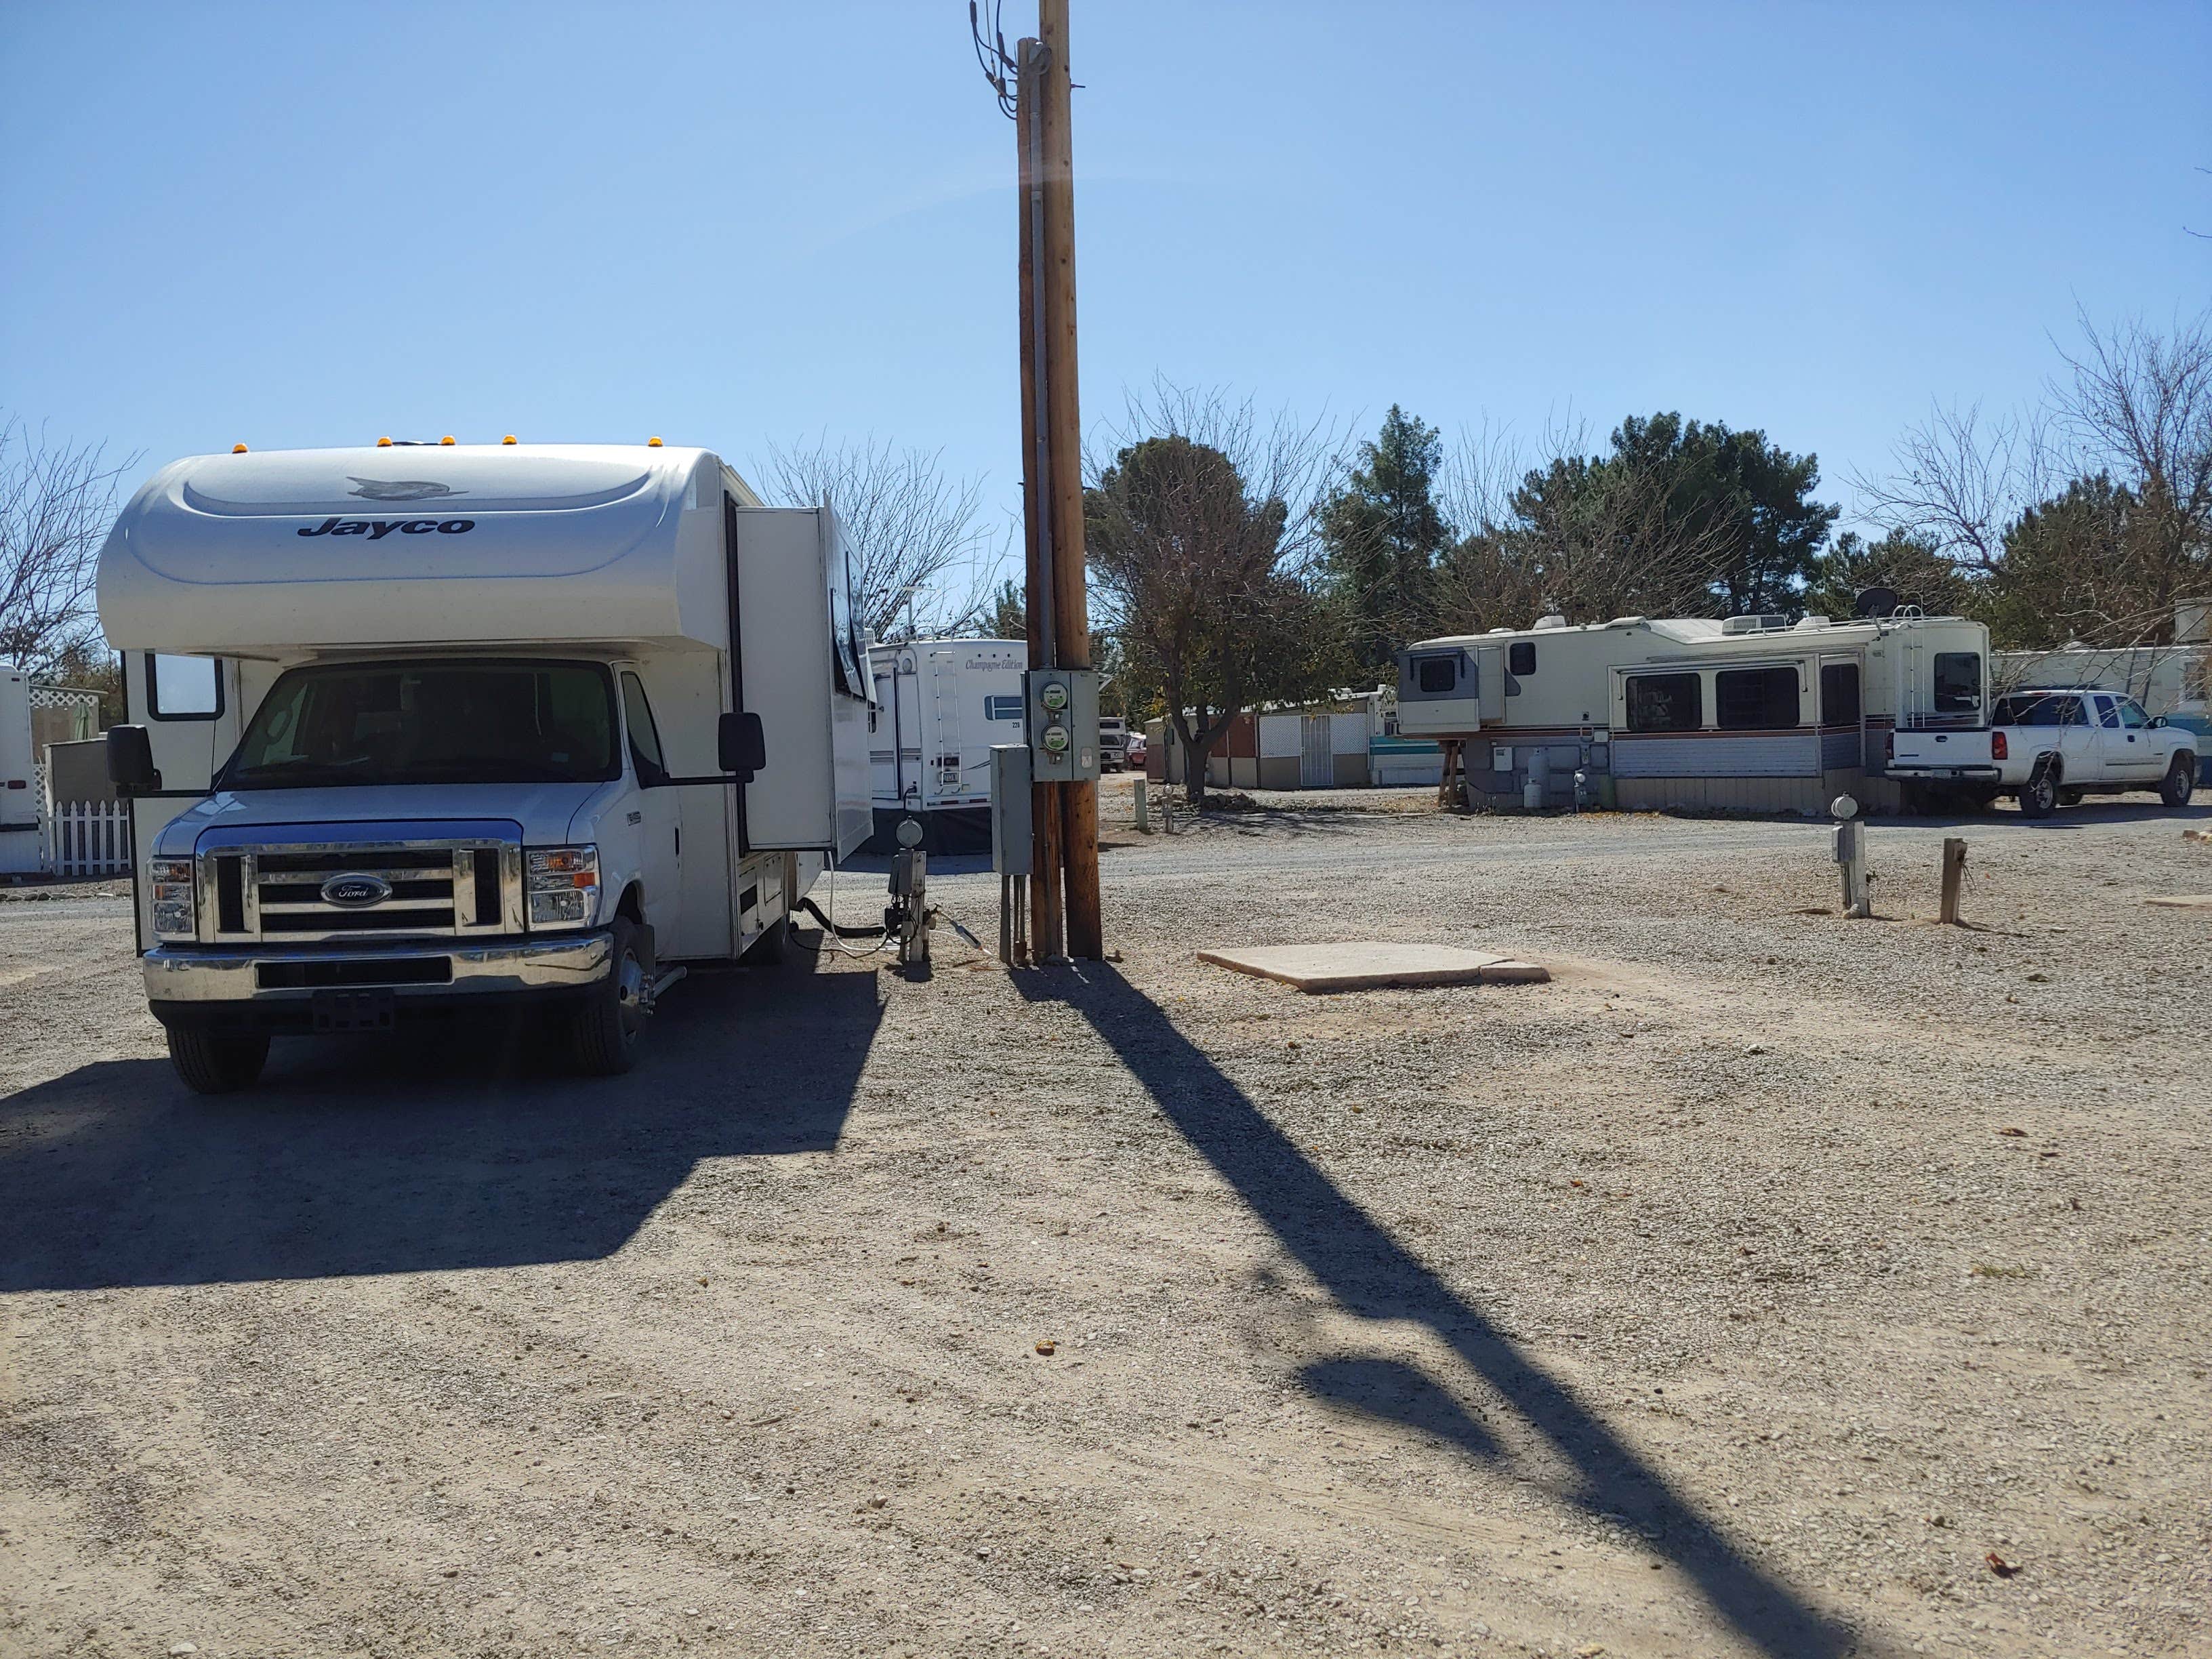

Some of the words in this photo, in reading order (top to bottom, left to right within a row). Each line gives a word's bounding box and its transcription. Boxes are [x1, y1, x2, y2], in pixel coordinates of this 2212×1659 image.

[297, 518, 475, 540] Jayco
[966, 659, 1001, 672] Champagne
[1002, 659, 1023, 670] Edition
[338, 884, 370, 897] Ford
